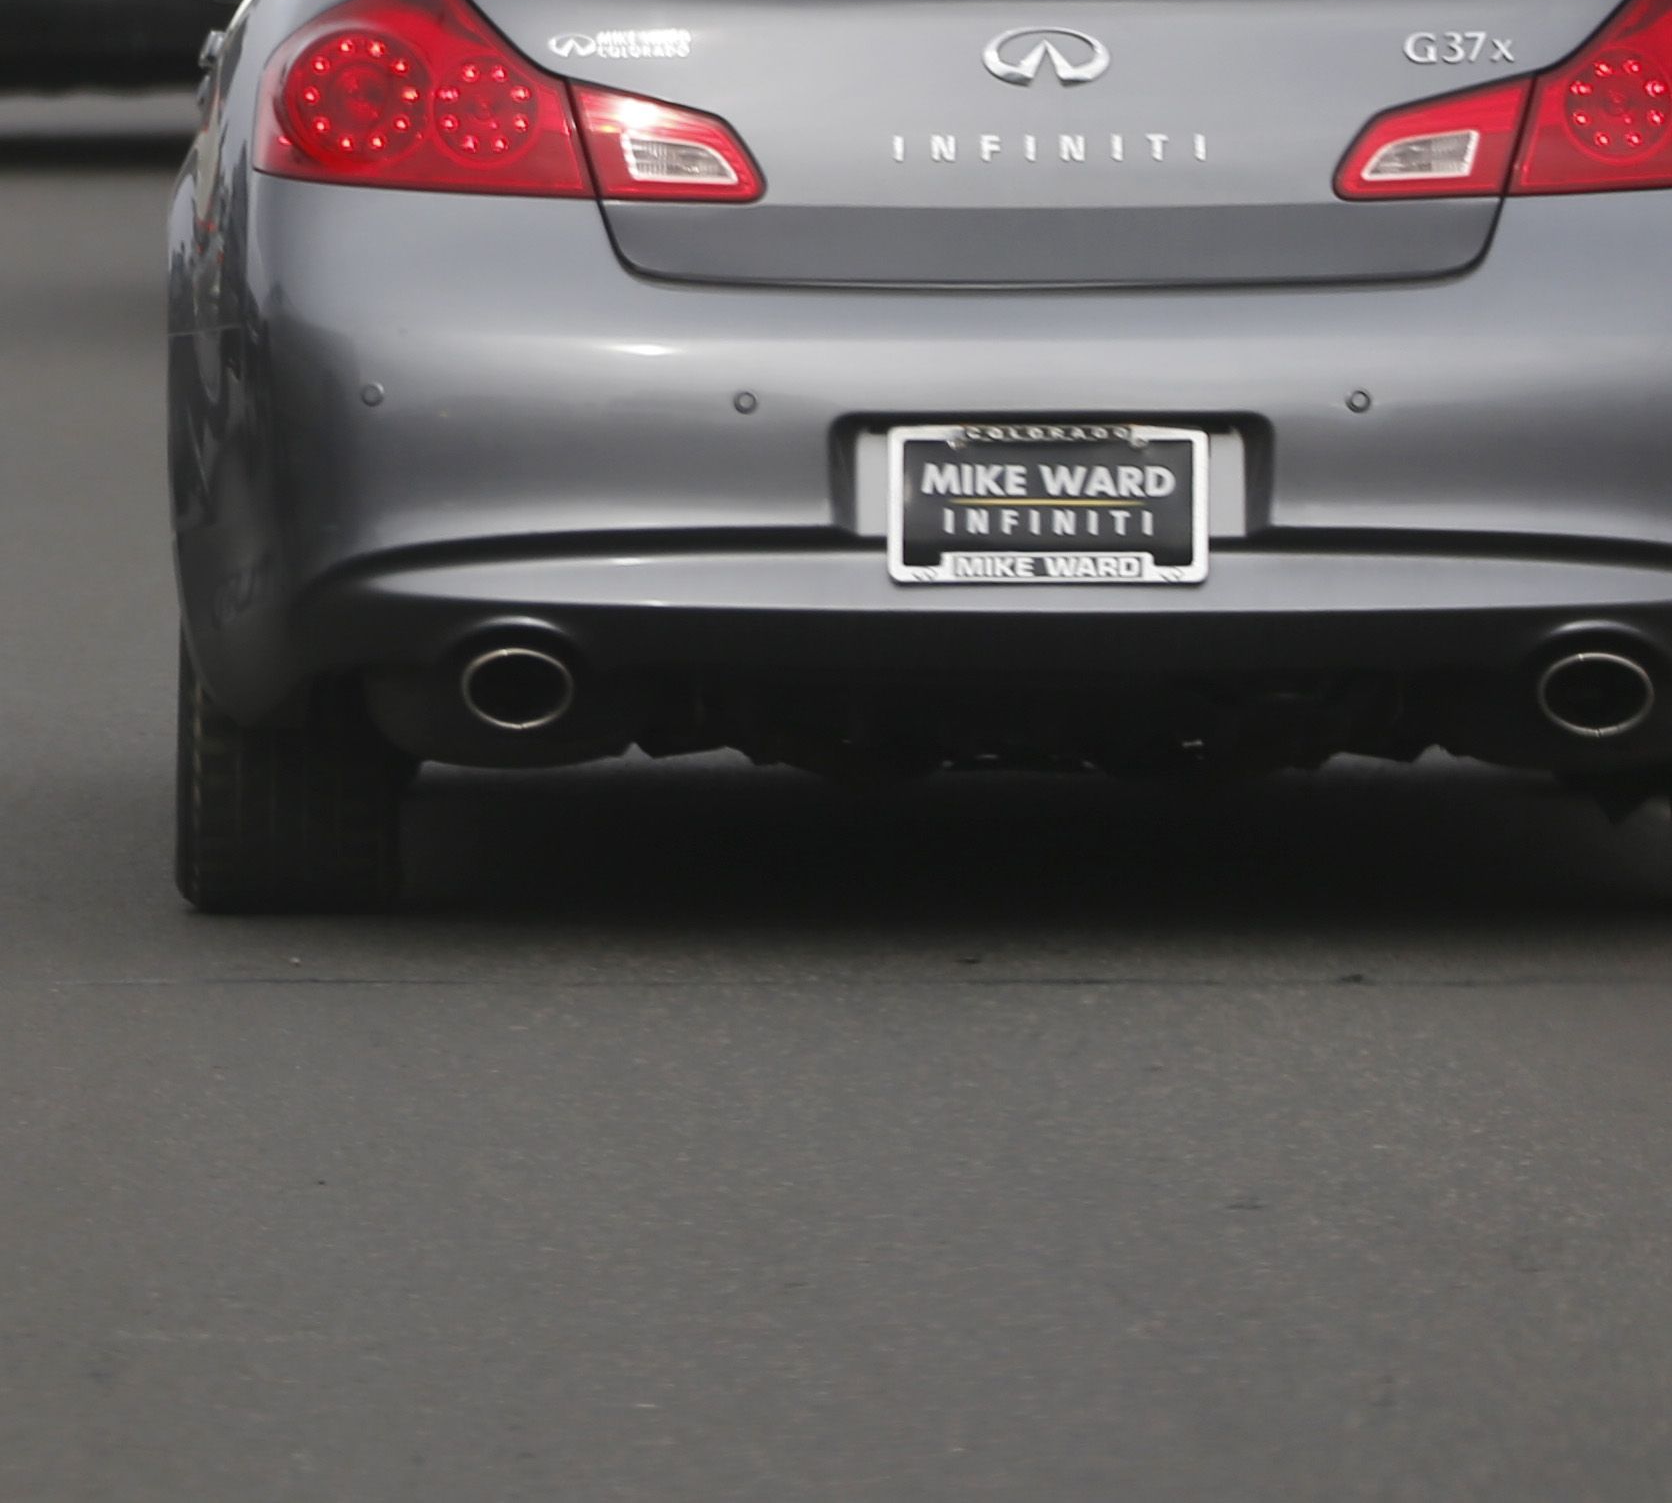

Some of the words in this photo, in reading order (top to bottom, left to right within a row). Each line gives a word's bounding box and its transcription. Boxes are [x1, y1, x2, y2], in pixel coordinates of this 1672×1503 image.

[1403, 31, 1515, 64] G37x
[892, 133, 1206, 162] INFINITI
[964, 425, 1130, 441] COLORADO
[921, 462, 1028, 497] MIKE
[1038, 464, 1177, 498] WARD
[942, 507, 1154, 537] INFINITI
[956, 556, 1034, 578] MIKE
[1043, 557, 1142, 579] WARD
